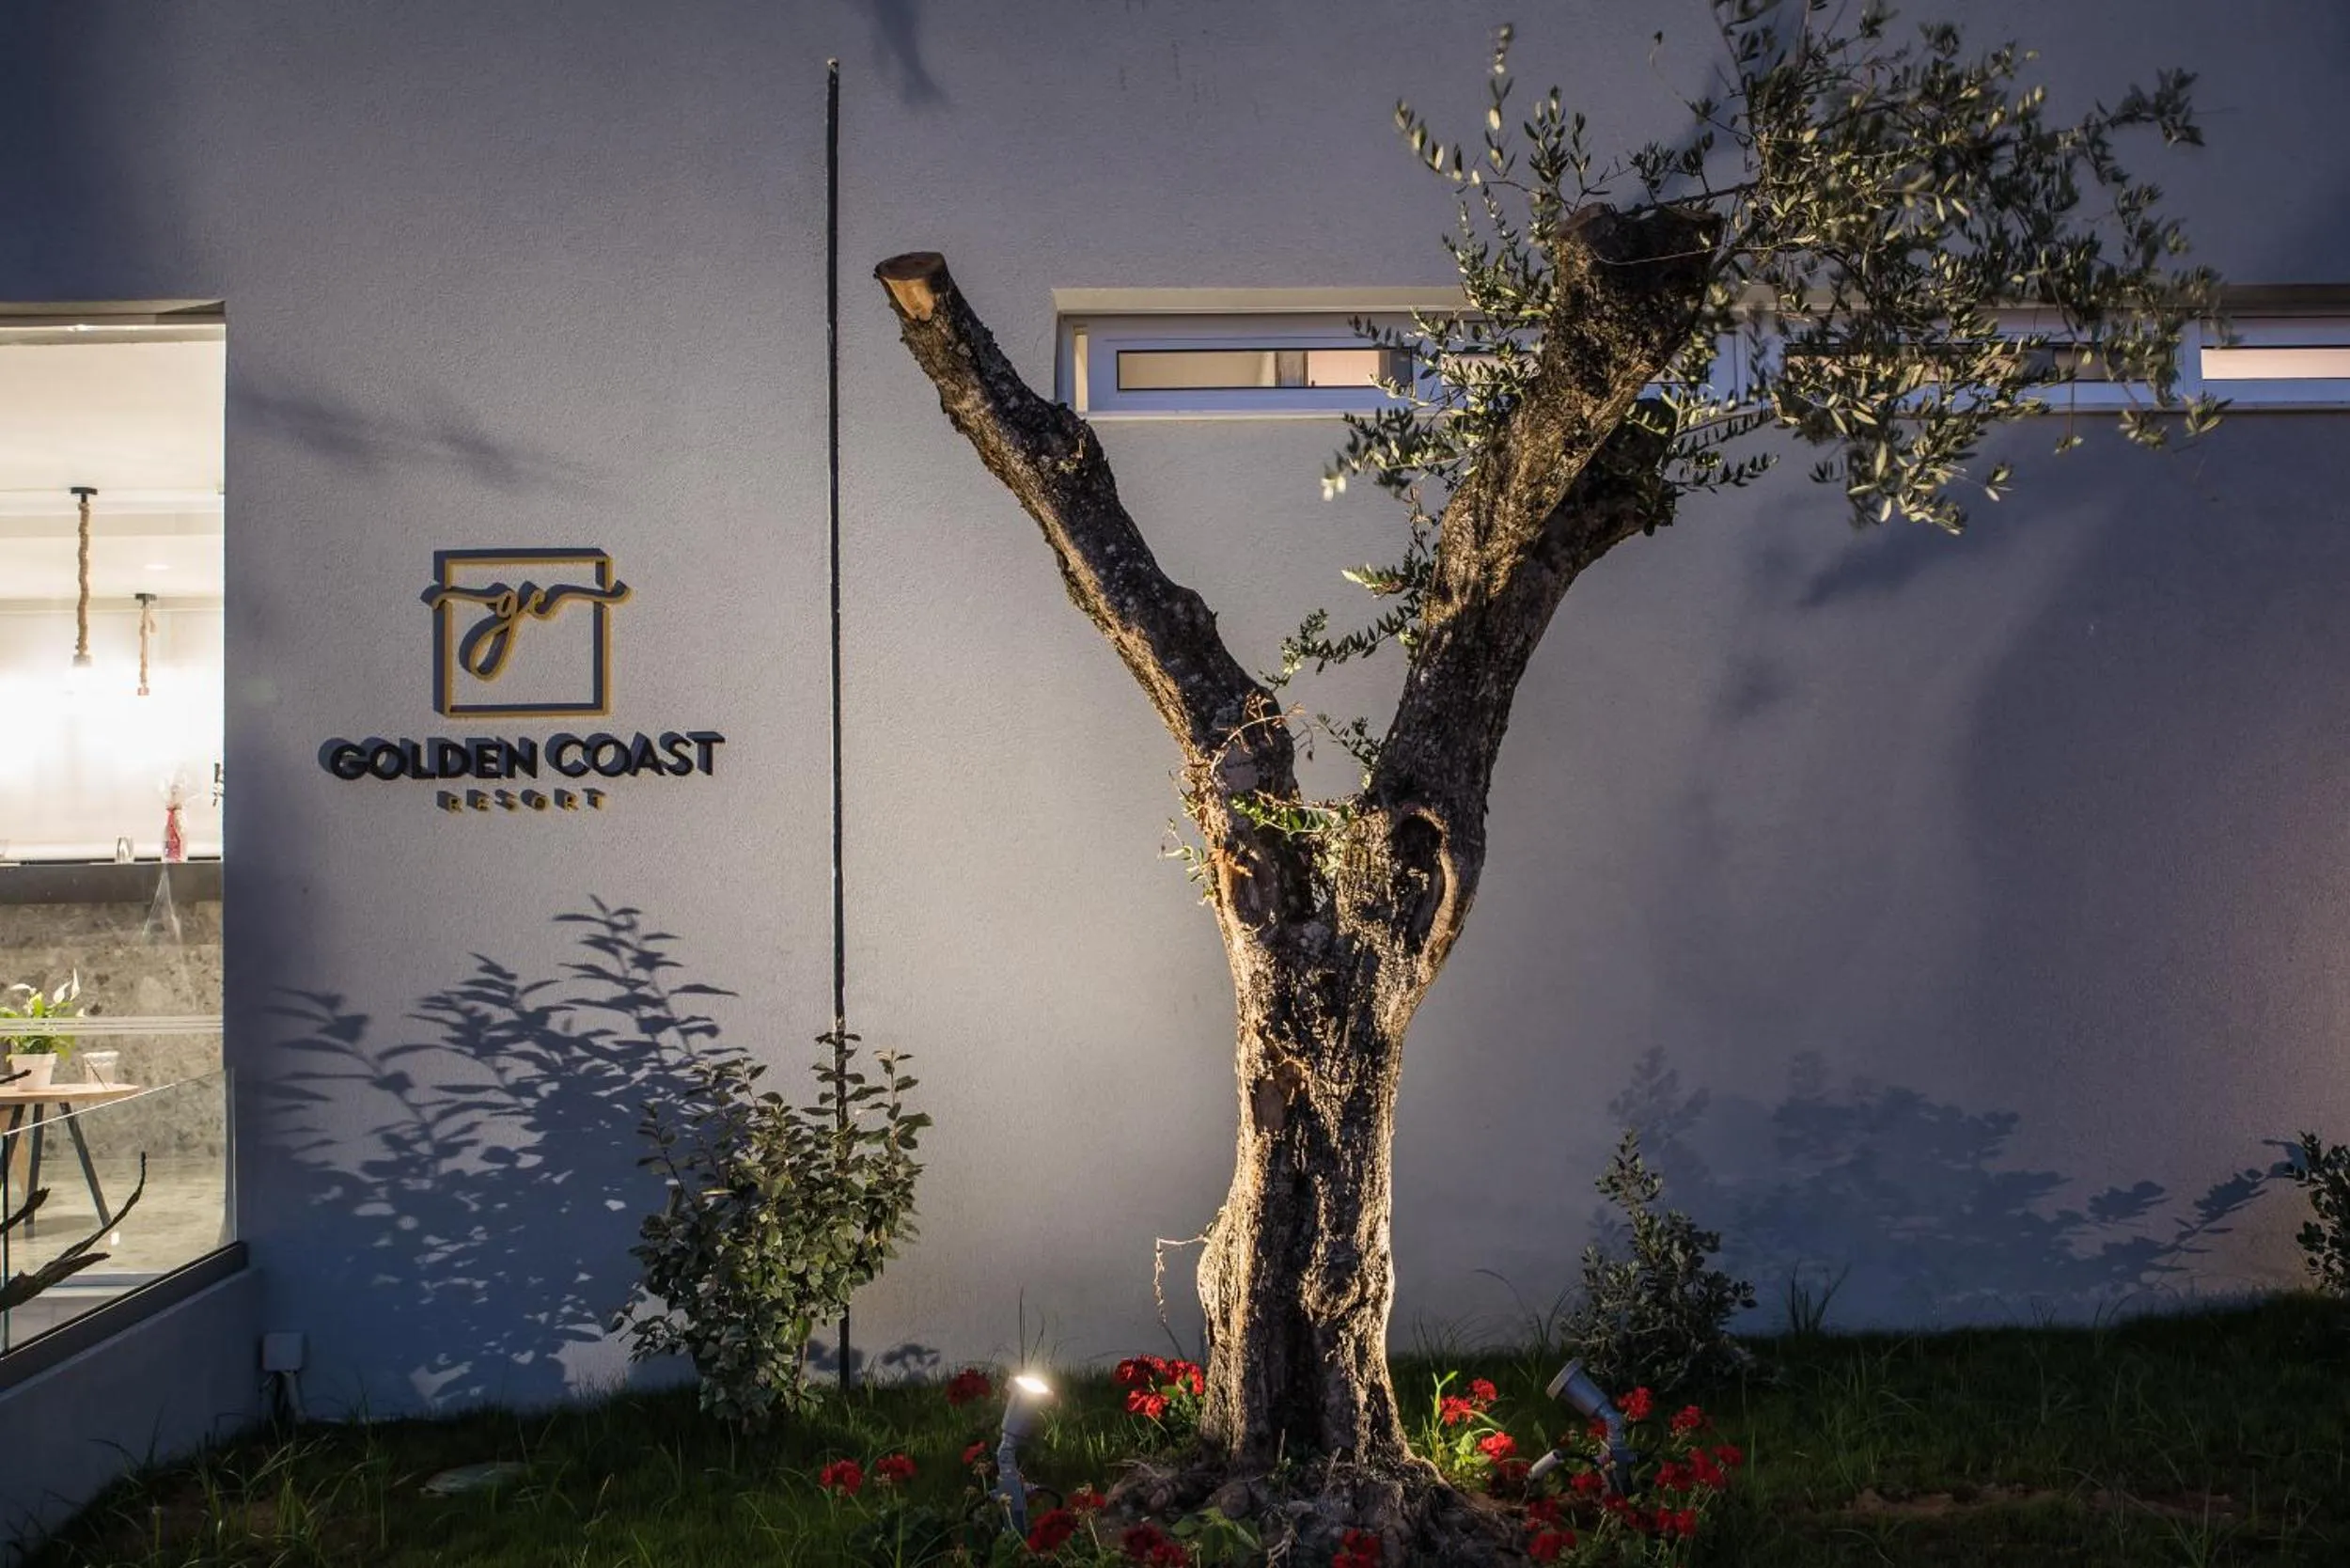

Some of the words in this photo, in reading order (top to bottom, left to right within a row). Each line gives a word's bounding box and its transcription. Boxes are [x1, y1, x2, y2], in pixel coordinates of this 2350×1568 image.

[325, 739, 539, 780] GOLDEN
[549, 732, 726, 778] COAST
[440, 788, 606, 812] RESORT
